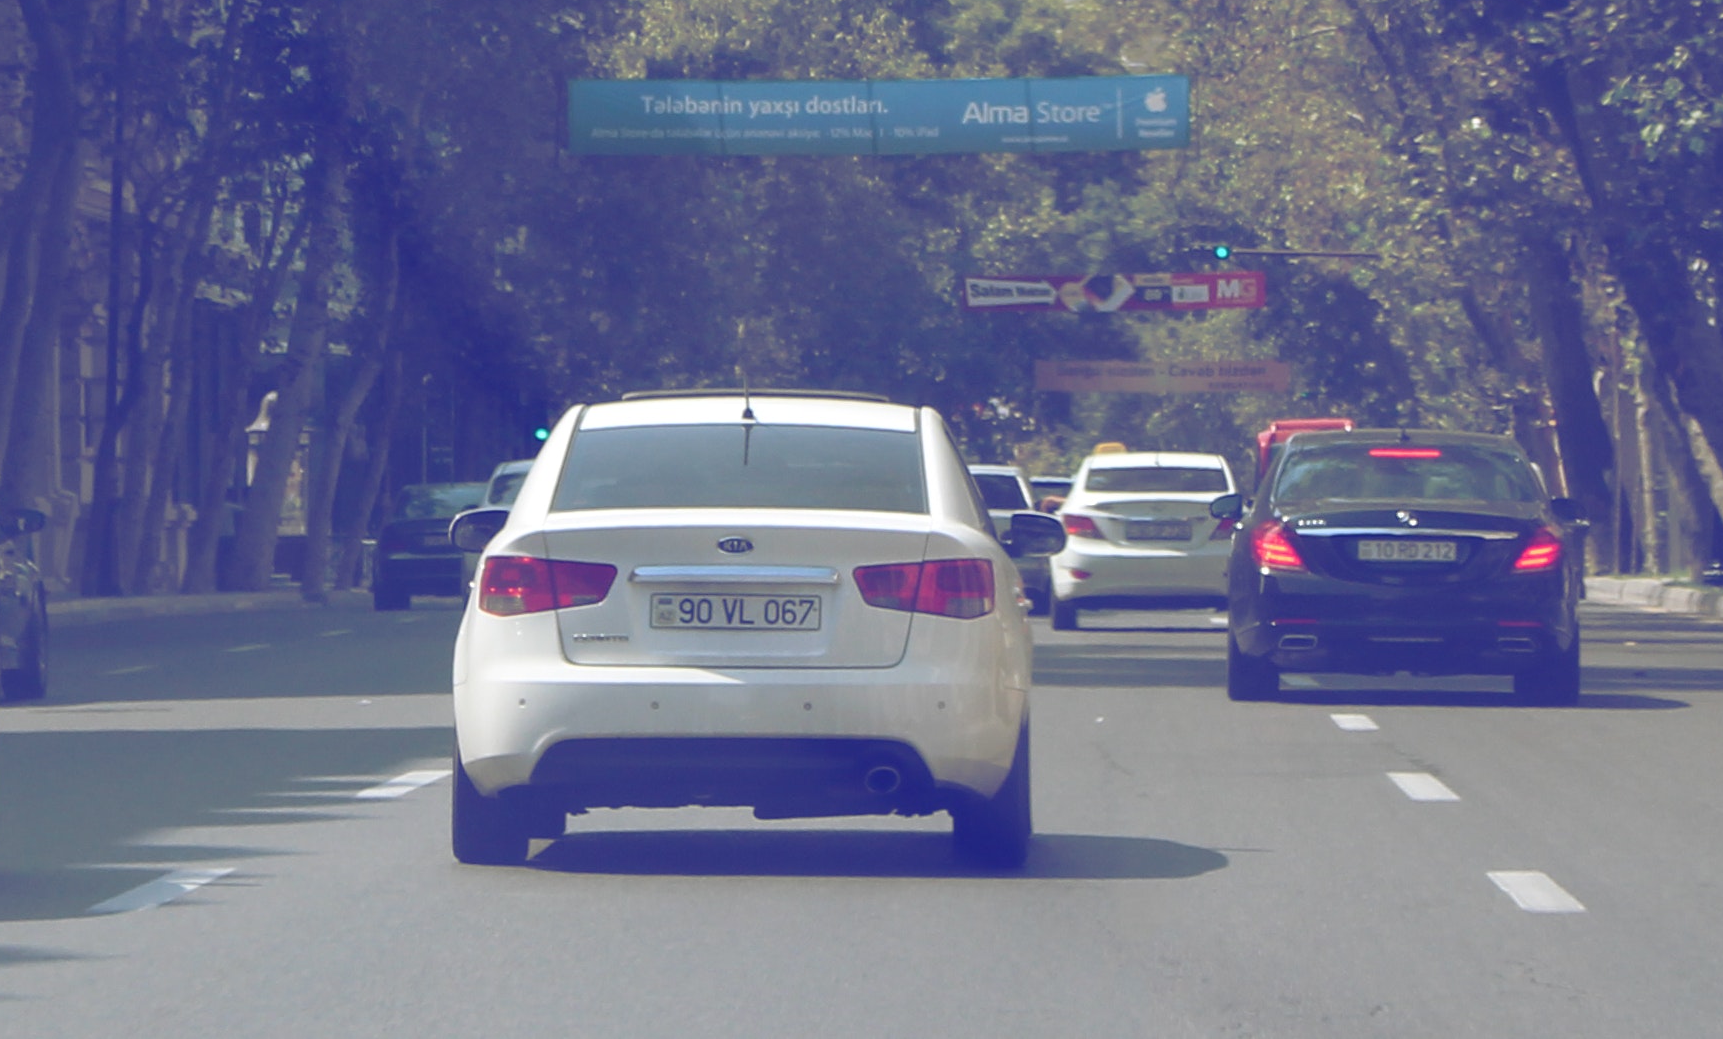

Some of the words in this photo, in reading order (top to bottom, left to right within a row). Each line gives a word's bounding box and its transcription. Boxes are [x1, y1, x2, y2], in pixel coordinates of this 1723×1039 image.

[641, 96, 742, 114] Tələbənin
[749, 98, 799, 118] yaxşı
[805, 96, 888, 115] dostları.
[963, 101, 1029, 124] Alma
[1036, 100, 1101, 123] Store
[678, 597, 713, 625] 90
[721, 598, 755, 626] VL
[764, 599, 815, 626] 067
